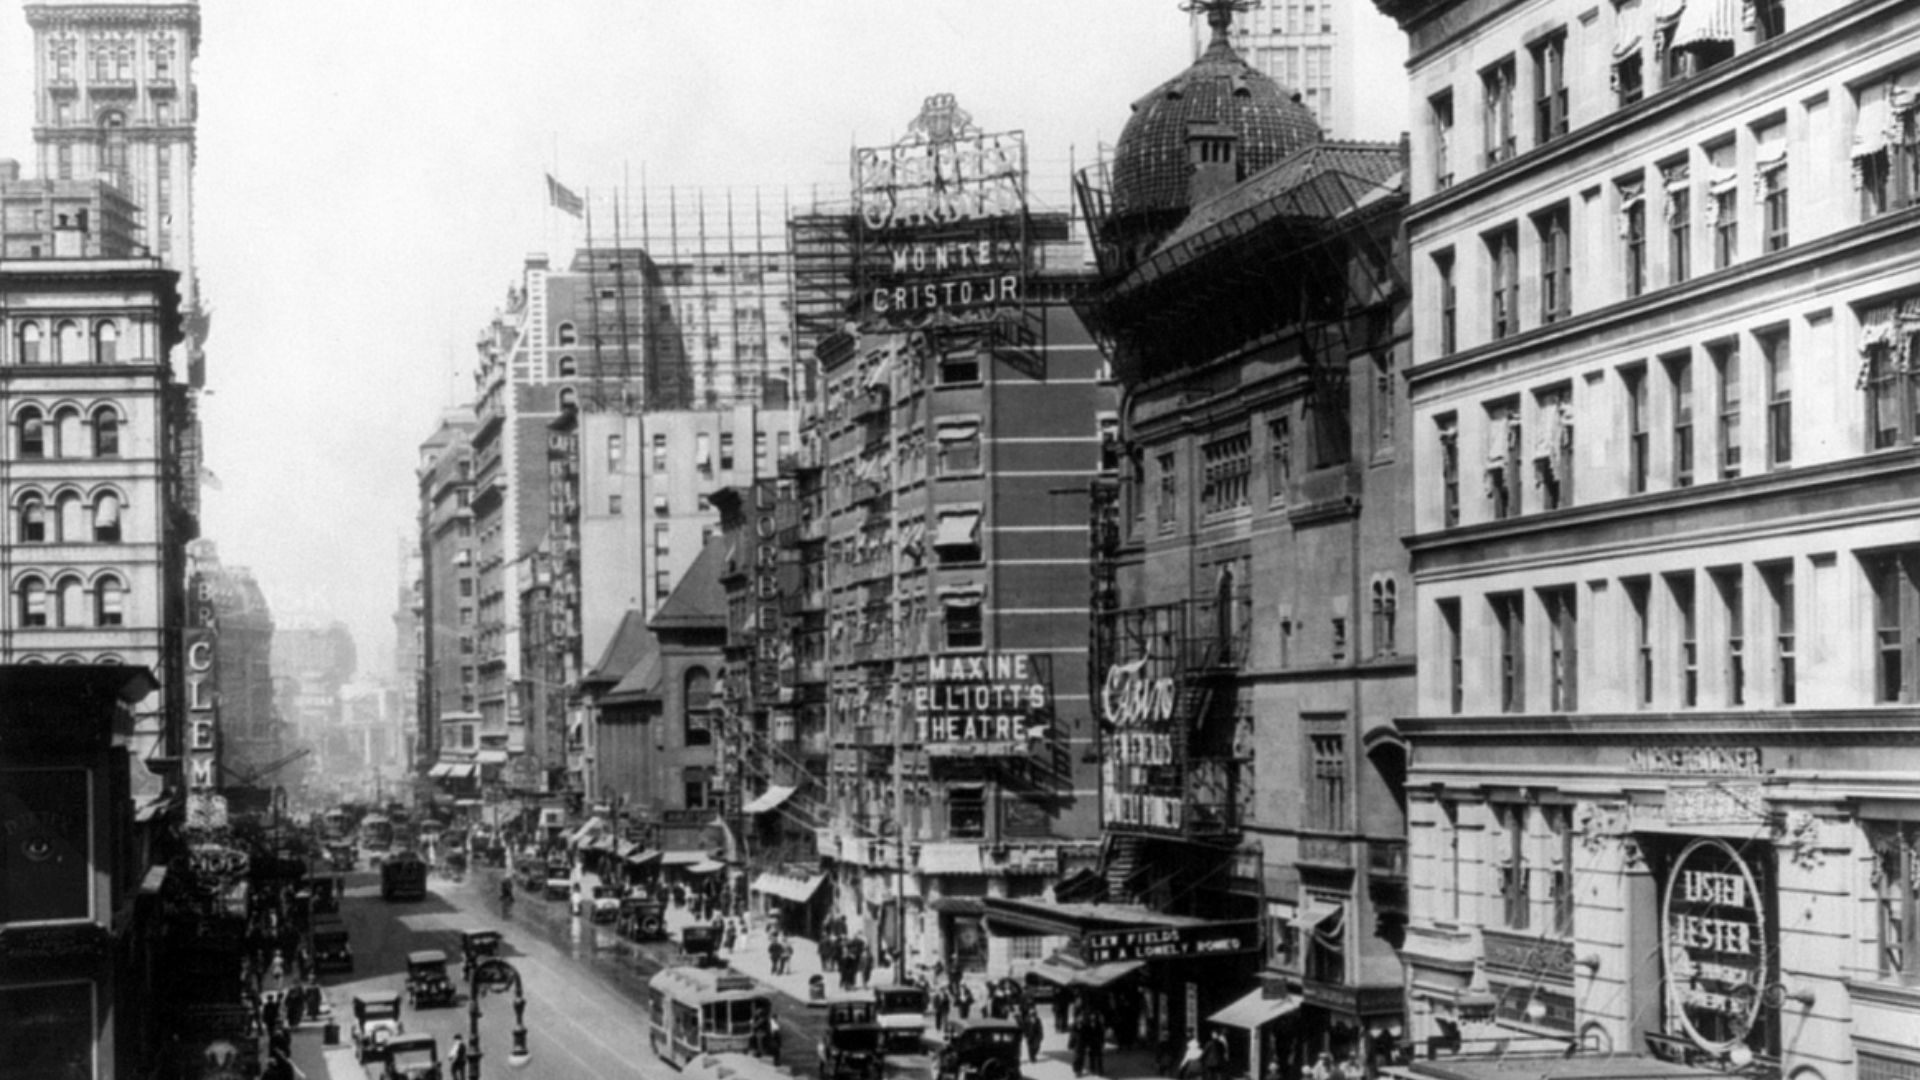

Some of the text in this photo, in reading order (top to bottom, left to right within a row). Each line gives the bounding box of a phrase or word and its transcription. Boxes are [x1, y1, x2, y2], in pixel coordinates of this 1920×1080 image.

[893, 241, 991, 273] MONTE
[873, 276, 1017, 312] CRISTO JR
[929, 654, 1028, 681] MAXINE
[915, 683, 1045, 711] ELLIOTT'S
[916, 714, 1026, 741] THEATRE
[1677, 914, 1750, 954] LESTER
